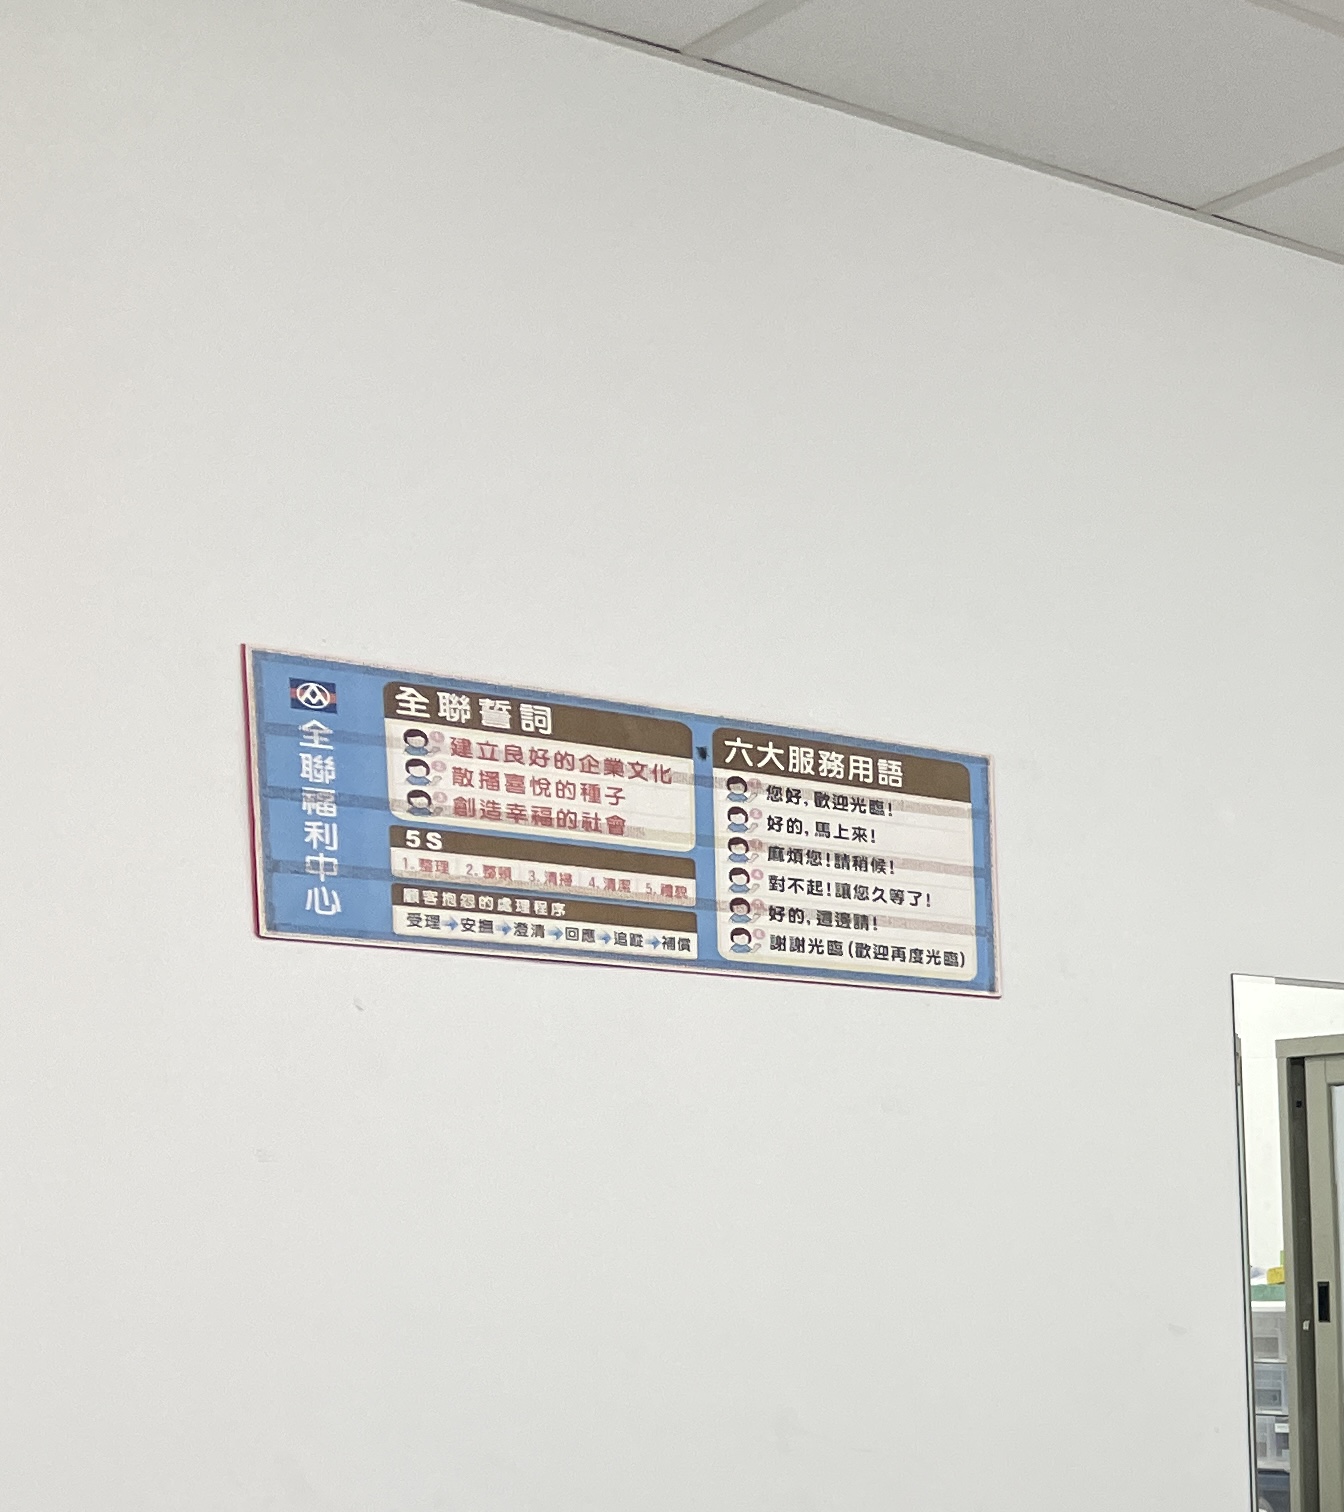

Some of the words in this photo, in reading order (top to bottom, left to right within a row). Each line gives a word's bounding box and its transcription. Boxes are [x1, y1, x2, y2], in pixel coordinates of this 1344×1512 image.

[395, 687, 553, 735] 全聯誓詞
[449, 736, 673, 785] 建立良好的企業文化
[724, 737, 903, 787] 六大服務用語
[451, 765, 626, 806] 散播喜悅的種子
[297, 719, 342, 916] 全聯福利中心
[453, 795, 627, 837] 創造幸福的社會
[403, 887, 566, 918] 顧客抱怨的處理程序
